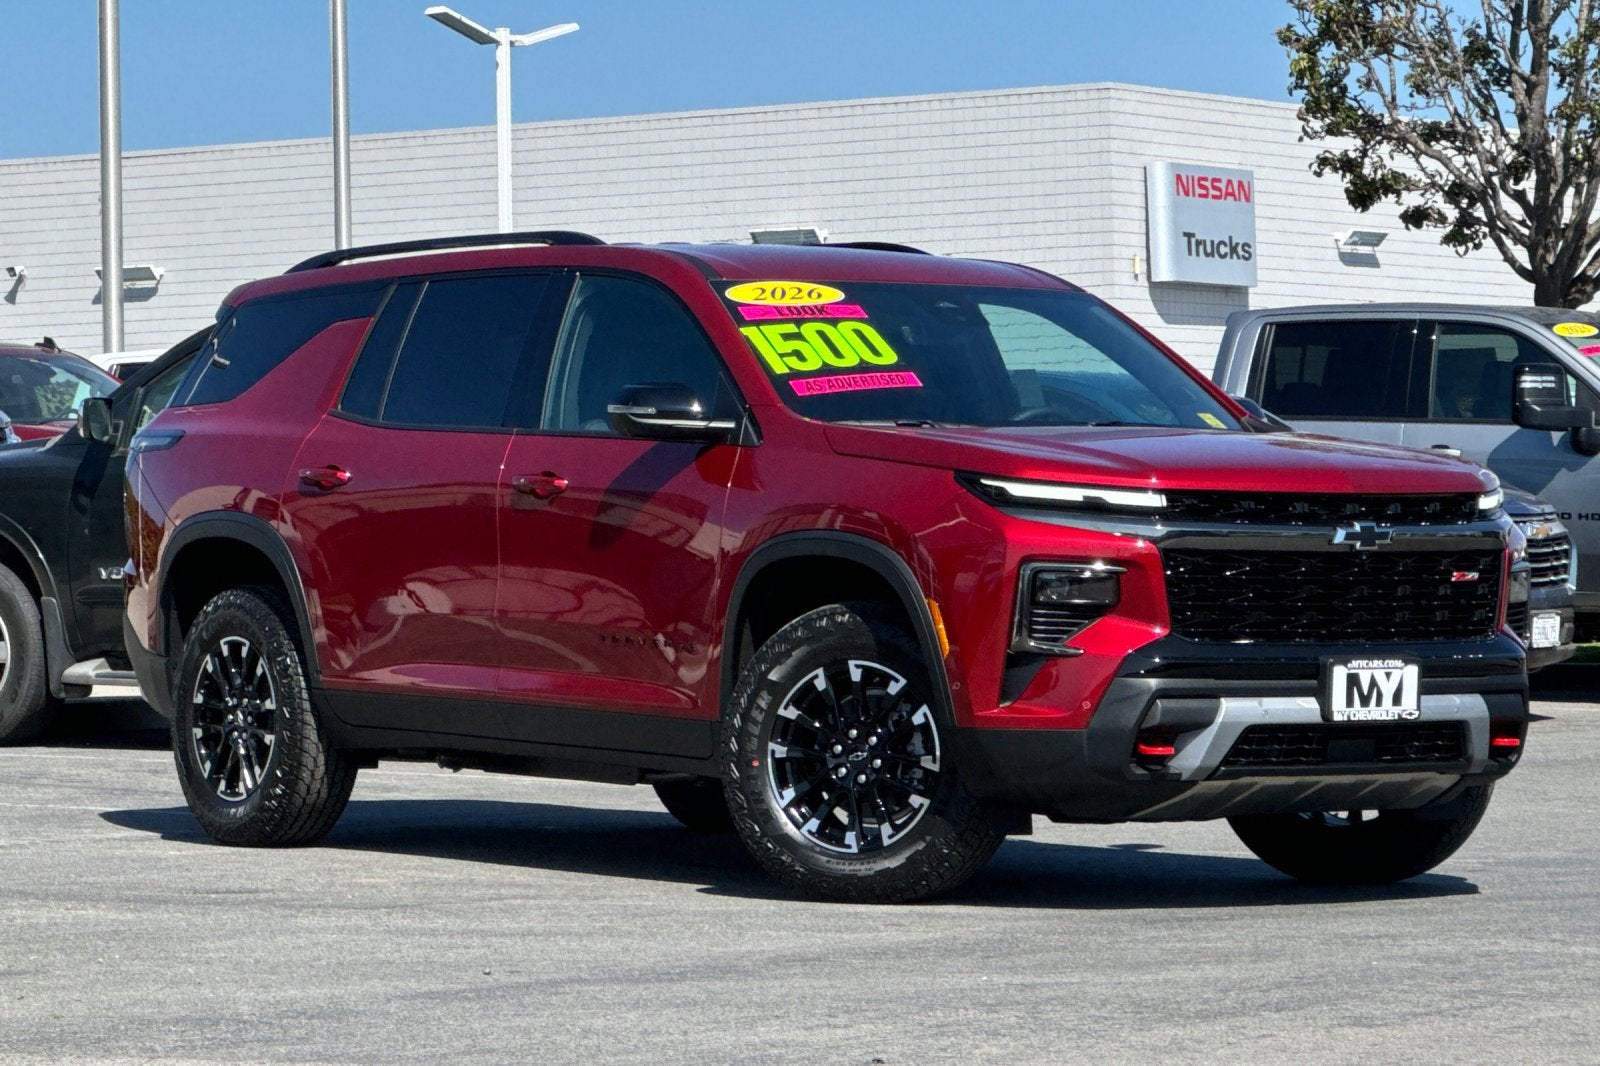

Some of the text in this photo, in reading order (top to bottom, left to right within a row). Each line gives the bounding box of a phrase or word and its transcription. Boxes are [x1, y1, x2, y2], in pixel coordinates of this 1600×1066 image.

[1175, 173, 1251, 203] NISSAN
[1182, 231, 1253, 261] Trucks
[752, 286, 823, 301] 2026
[775, 305, 830, 316] LOOK
[739, 321, 899, 375] 1500
[805, 375, 908, 393] AS ADVERTISED
[1556, 512, 1572, 520] 0
[1345, 671, 1403, 709] MY
[1350, 710, 1400, 720] CHEVROLET
